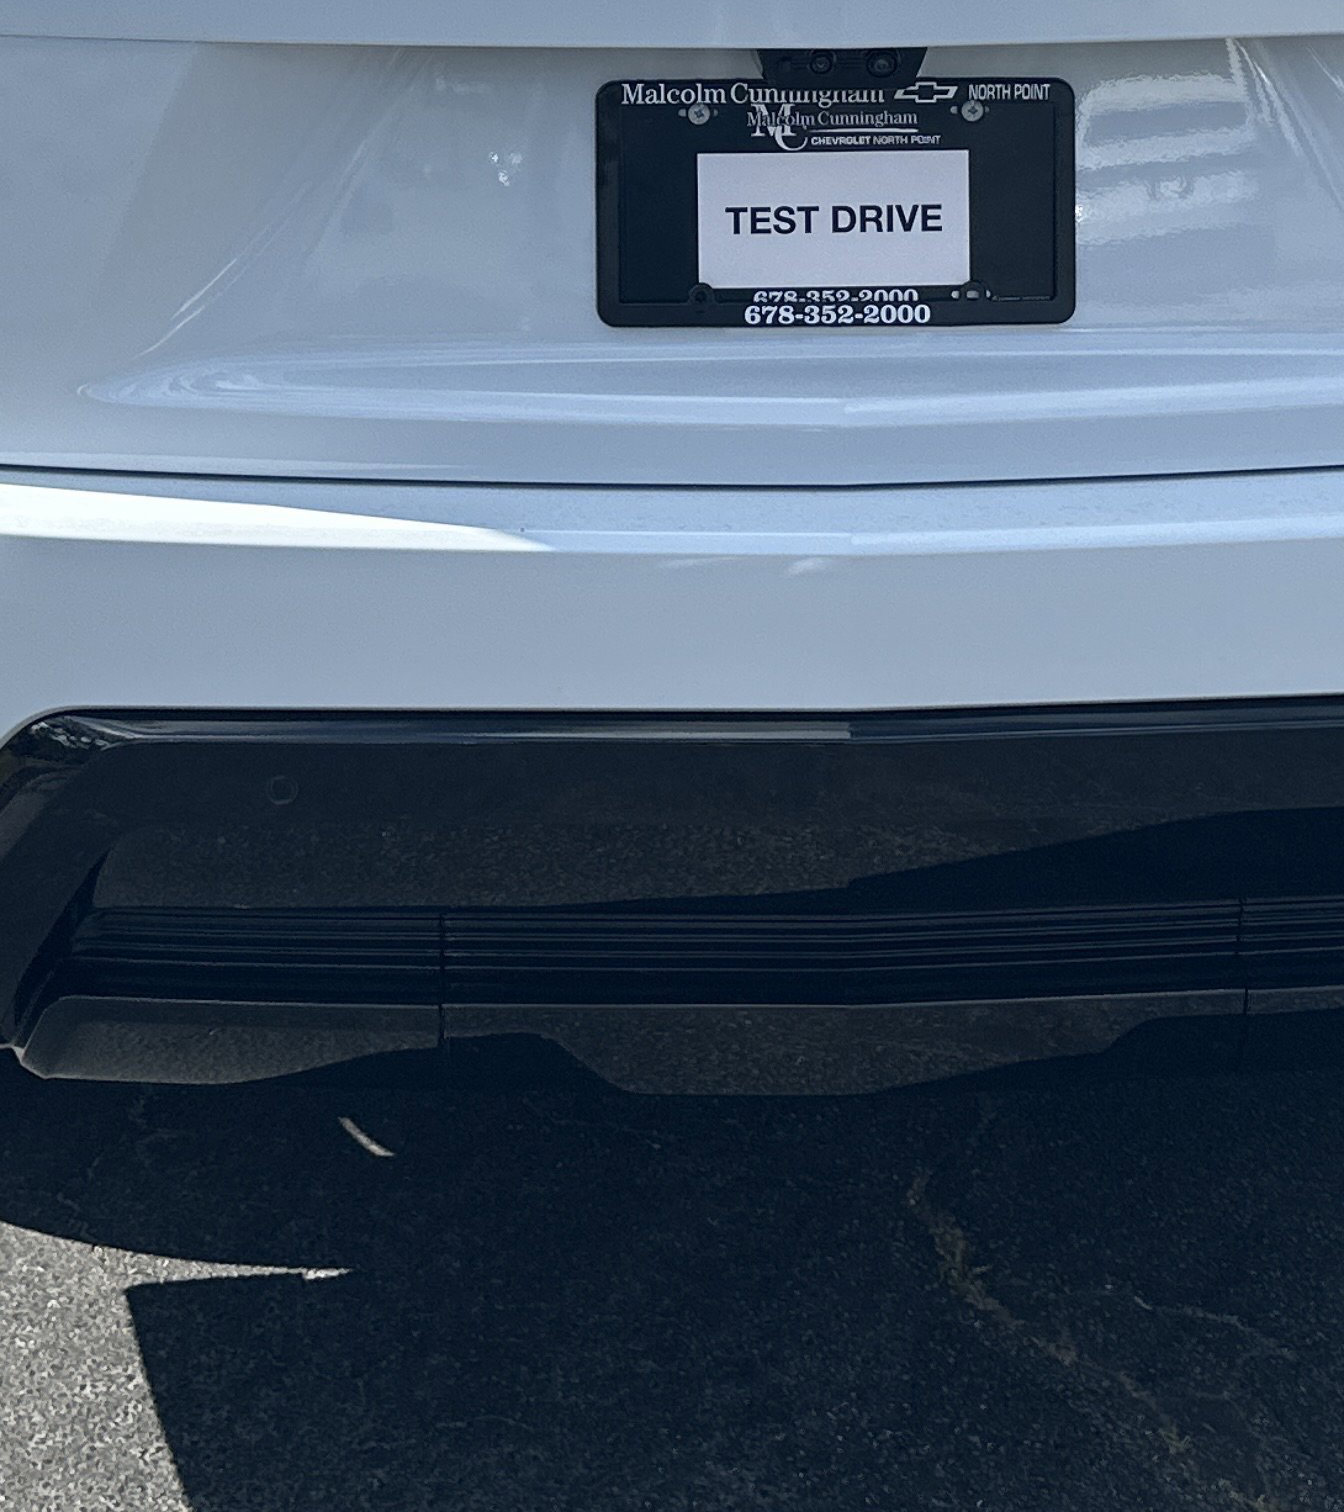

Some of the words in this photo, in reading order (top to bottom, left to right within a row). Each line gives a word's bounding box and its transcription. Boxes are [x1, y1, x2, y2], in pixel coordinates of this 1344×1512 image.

[621, 83, 727, 105] Malcolm
[730, 82, 885, 108] Cunningham
[968, 83, 1011, 101] NORTH
[1014, 83, 1051, 100] POINT
[746, 110, 815, 128] Malcolm
[817, 109, 918, 128] Cunningham
[810, 135, 871, 146] CHEVROLET
[872, 135, 908, 145] NORTH
[910, 134, 942, 144] POINT
[724, 205, 820, 235] TEST
[831, 204, 943, 234] DRIVE
[744, 304, 932, 325] 678-352-2000
